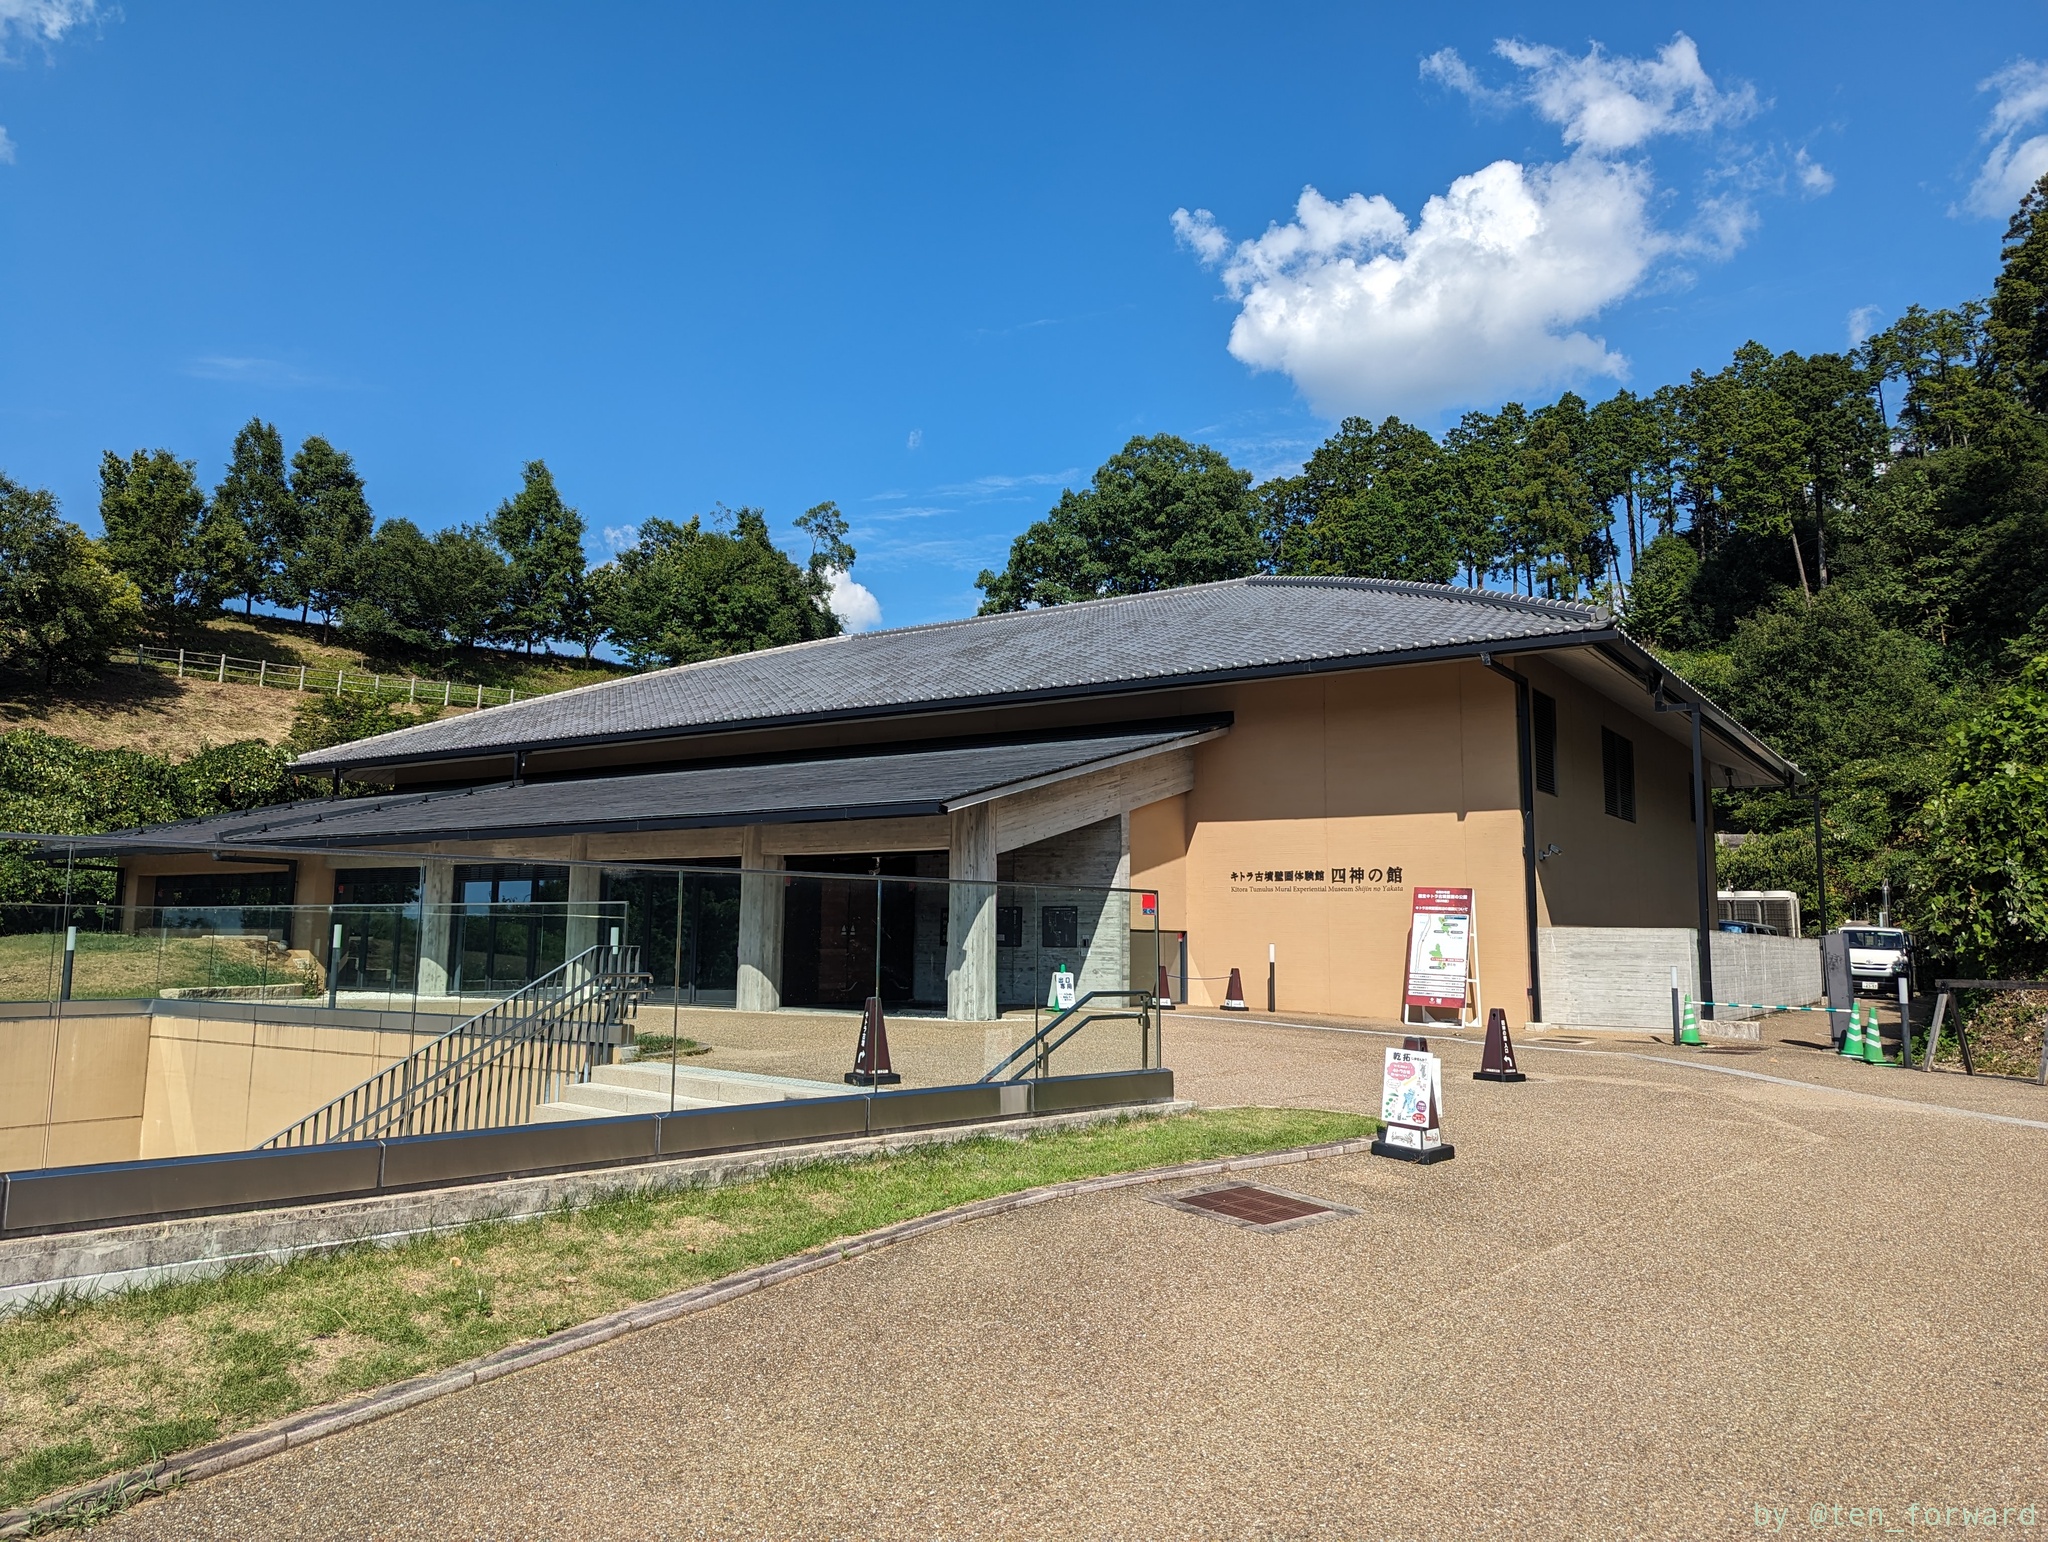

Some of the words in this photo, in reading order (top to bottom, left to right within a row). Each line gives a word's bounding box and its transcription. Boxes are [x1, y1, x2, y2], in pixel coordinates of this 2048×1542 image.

[1231, 870, 1325, 882] キトラ古墳壁画体験館
[1331, 866, 1403, 884] 四神の館
[1293, 886, 1326, 894] Experiential
[1355, 885, 1372, 893] Shijin
